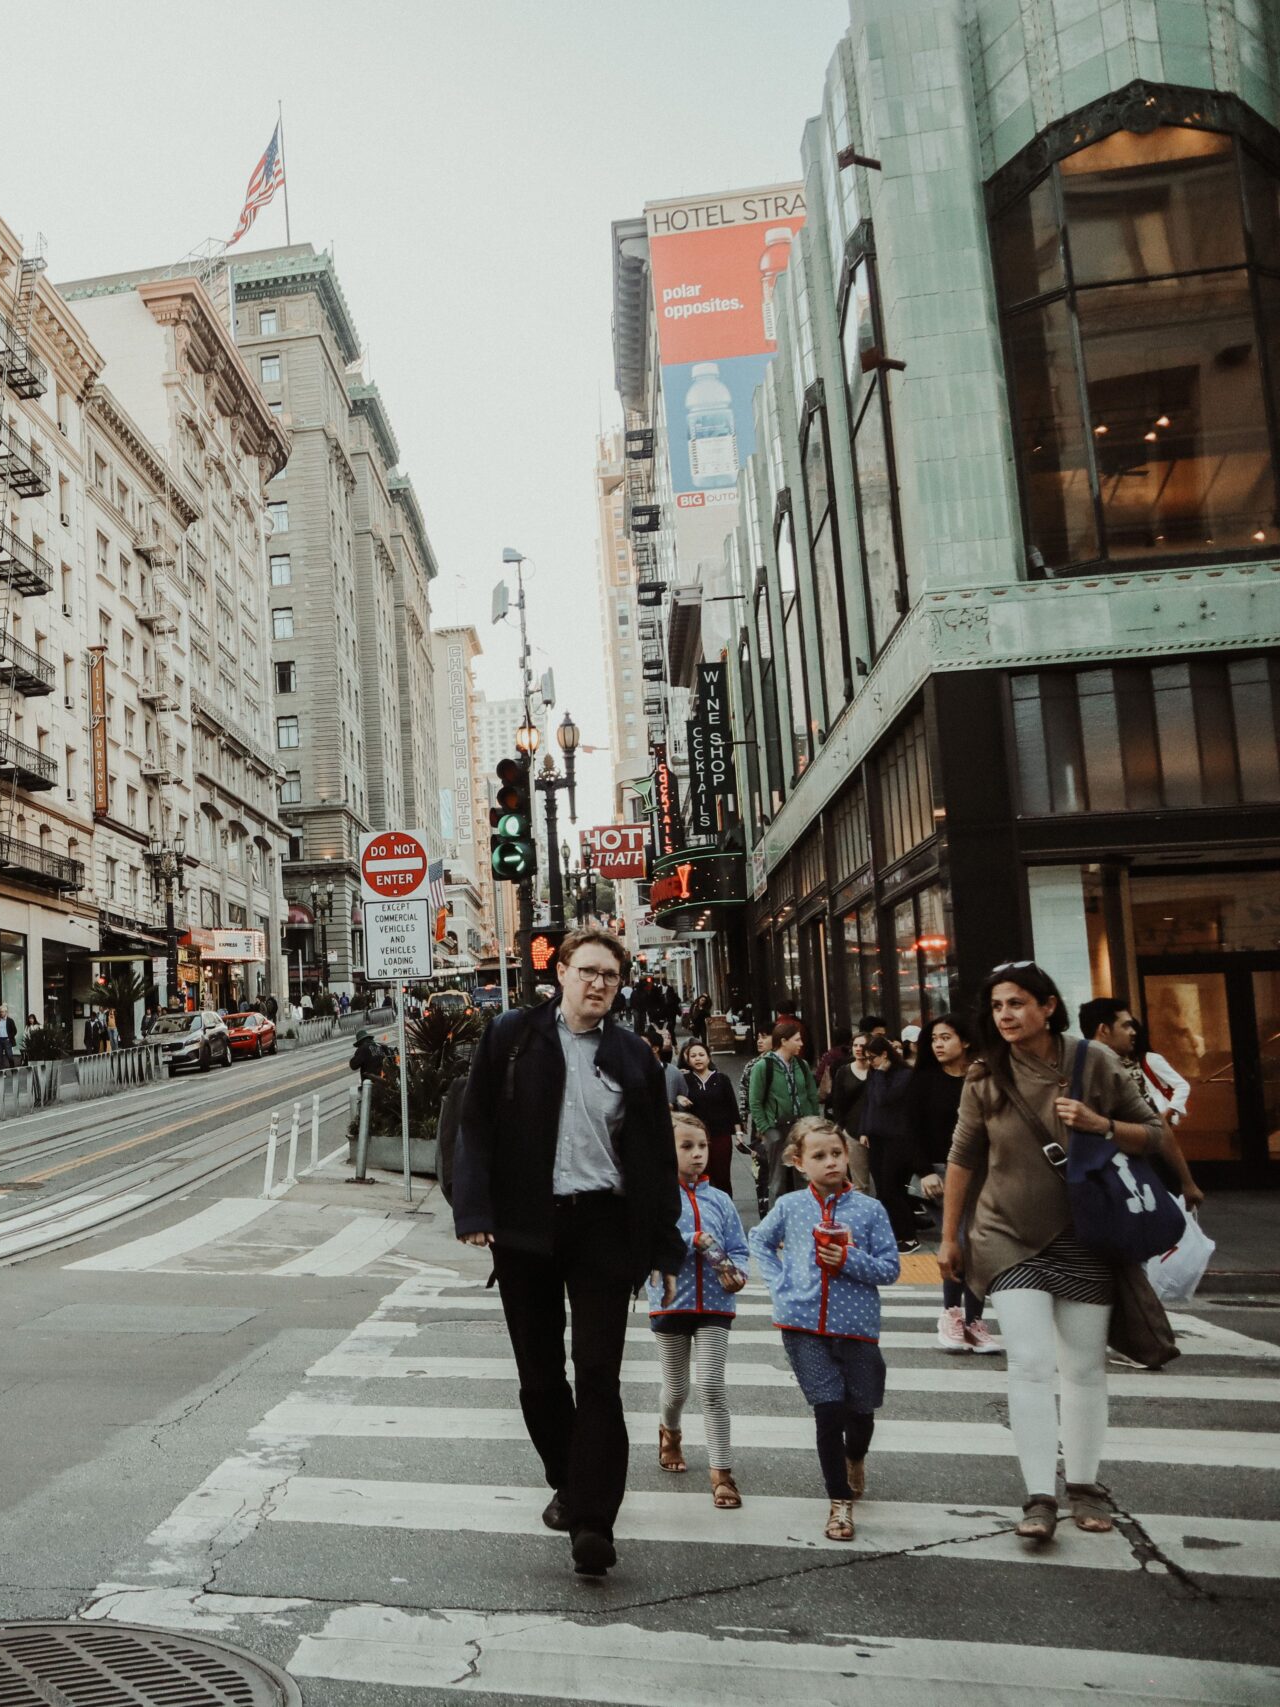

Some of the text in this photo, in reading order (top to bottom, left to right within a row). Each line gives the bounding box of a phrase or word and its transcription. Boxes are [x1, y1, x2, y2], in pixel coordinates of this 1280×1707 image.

[653, 205, 735, 233] HOTEL
[663, 283, 702, 302] polar
[664, 297, 744, 319] opposites.
[680, 494, 703, 507] BIG
[703, 670, 726, 787] WINE SHOP
[448, 645, 471, 840] CHANCELLOR HOTEL
[658, 763, 673, 855] COCKTAILS
[370, 843, 417, 857] DO NOT
[376, 873, 414, 886] ENTER
[381, 903, 410, 912] EXCEPT
[374, 913, 418, 923] COMMERCIAL
[379, 924, 416, 933] VEHICLES
[390, 936, 406, 944] AND
[380, 946, 417, 955] VEHICLES
[383, 957, 414, 966] LOADING
[378, 967, 420, 976] ON POWELL
